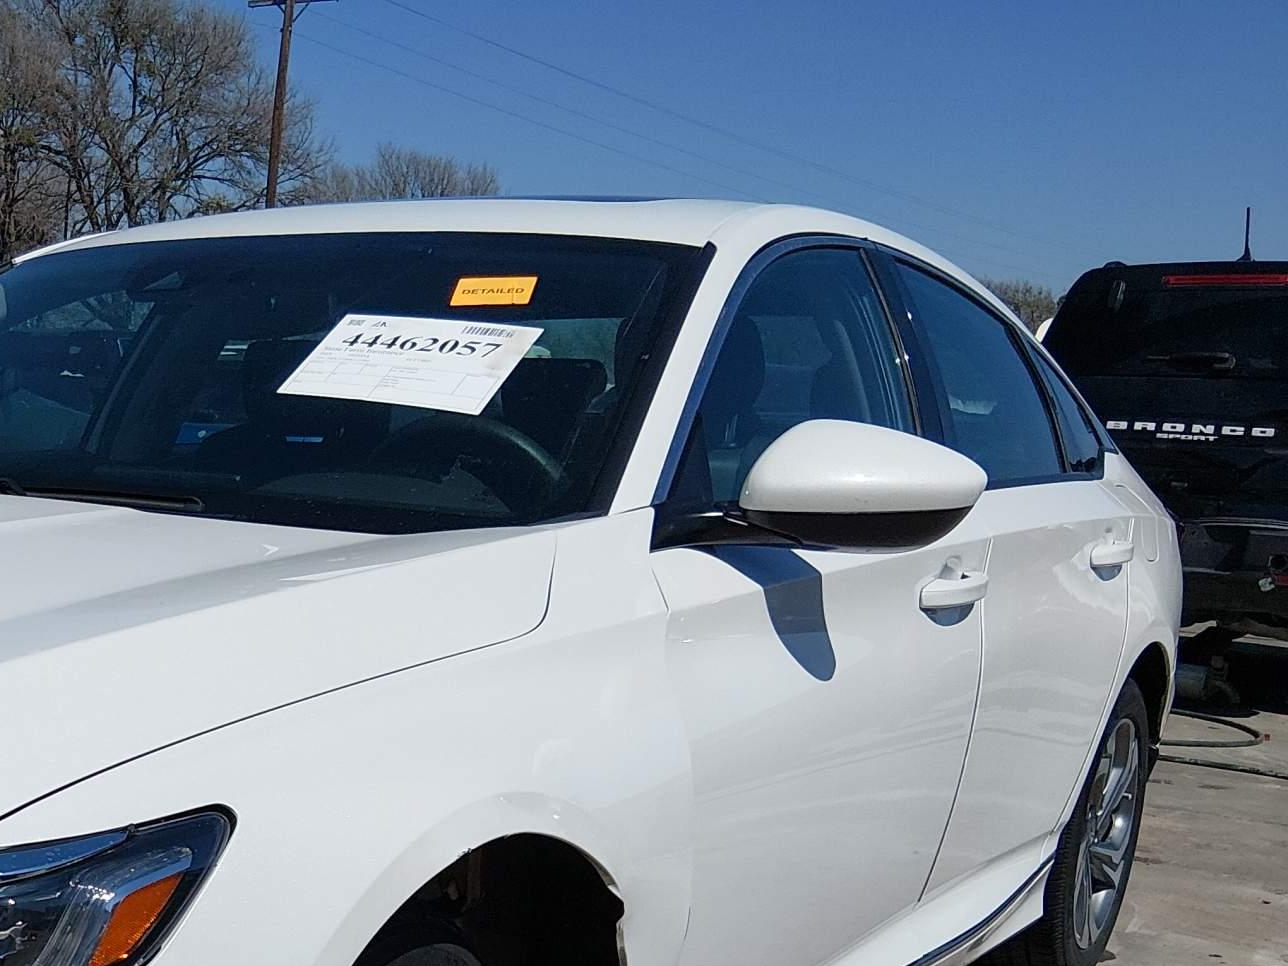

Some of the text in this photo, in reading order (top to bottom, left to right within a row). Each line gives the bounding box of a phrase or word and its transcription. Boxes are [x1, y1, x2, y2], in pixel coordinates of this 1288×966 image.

[461, 287, 525, 295] DETAILED
[342, 333, 503, 358] 44462057
[1106, 421, 1275, 437] BRONCO
[1156, 433, 1218, 441] SPORT
